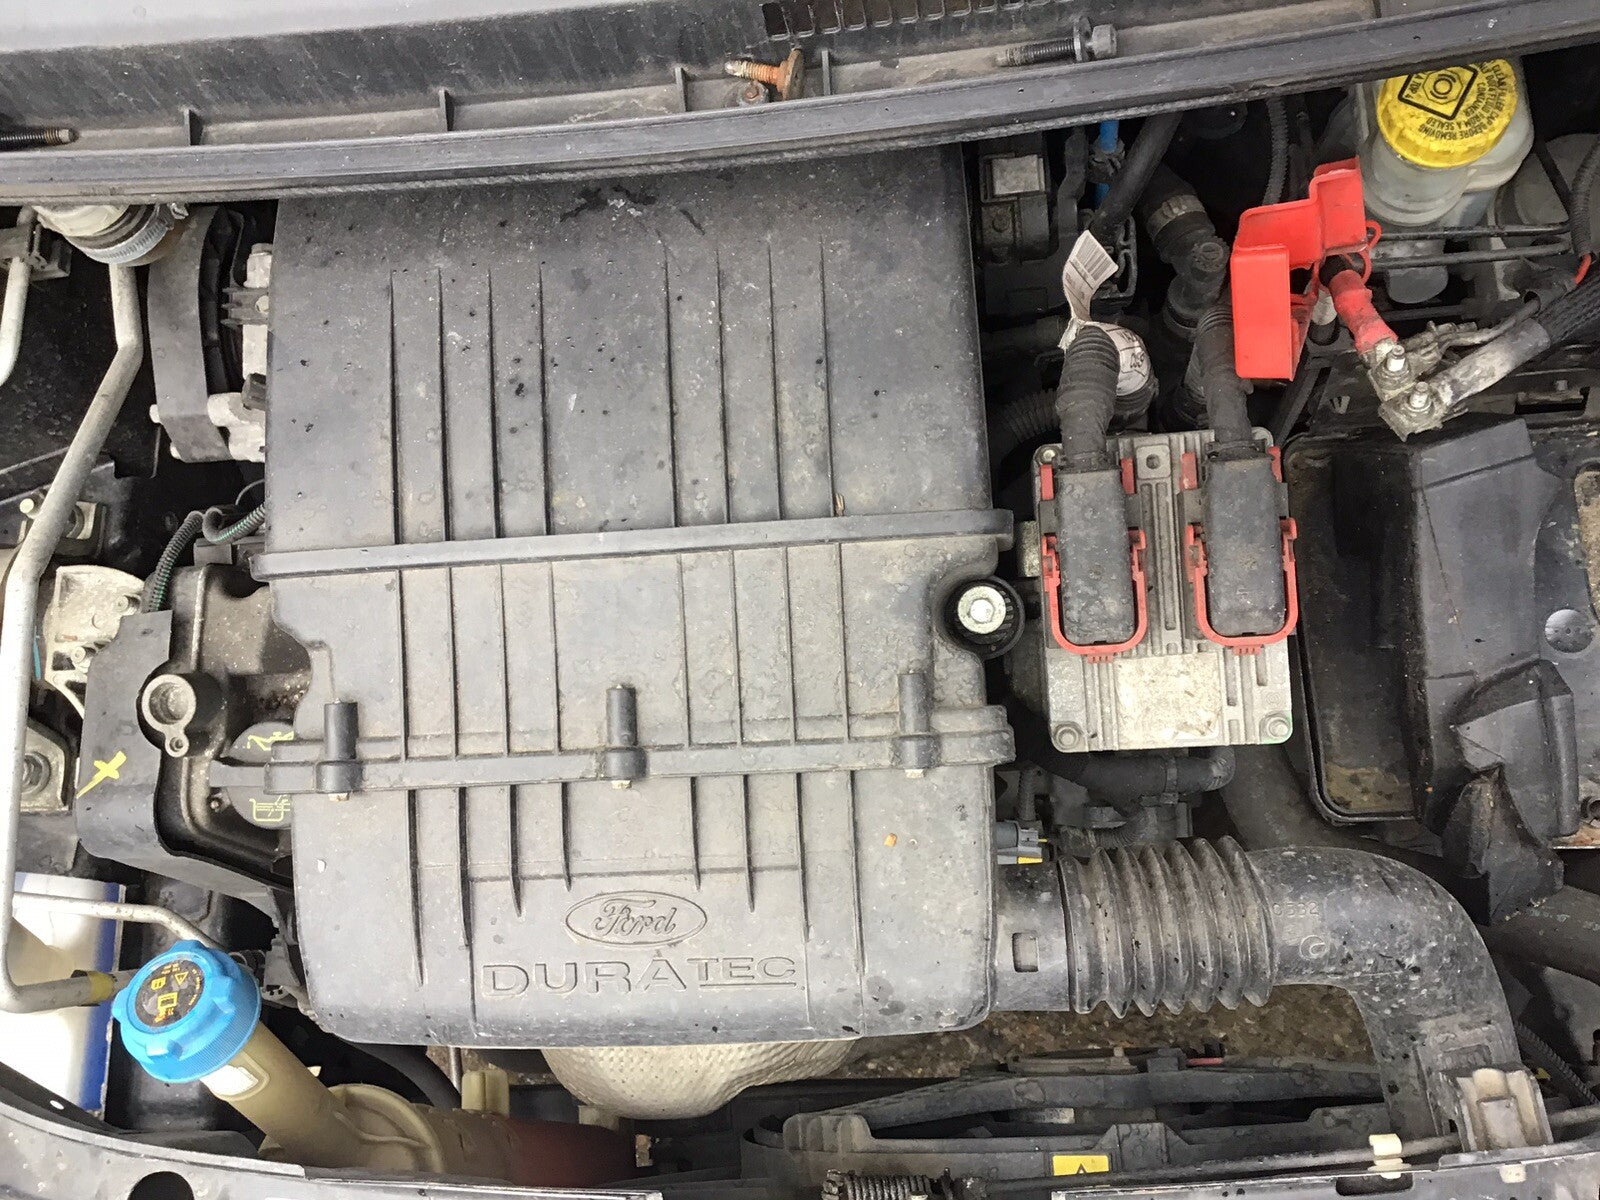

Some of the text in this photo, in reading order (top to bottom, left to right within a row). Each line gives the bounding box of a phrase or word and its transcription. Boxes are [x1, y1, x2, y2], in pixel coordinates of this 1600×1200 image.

[1463, 82, 1486, 117] CONTAINER
[1426, 117, 1455, 131] SEALED
[1464, 112, 1486, 128] FROM
[1486, 112, 1500, 126] CAP
[1418, 124, 1457, 140] REMOVING
[594, 897, 677, 937] Ford
[481, 955, 797, 998] DURATEC
